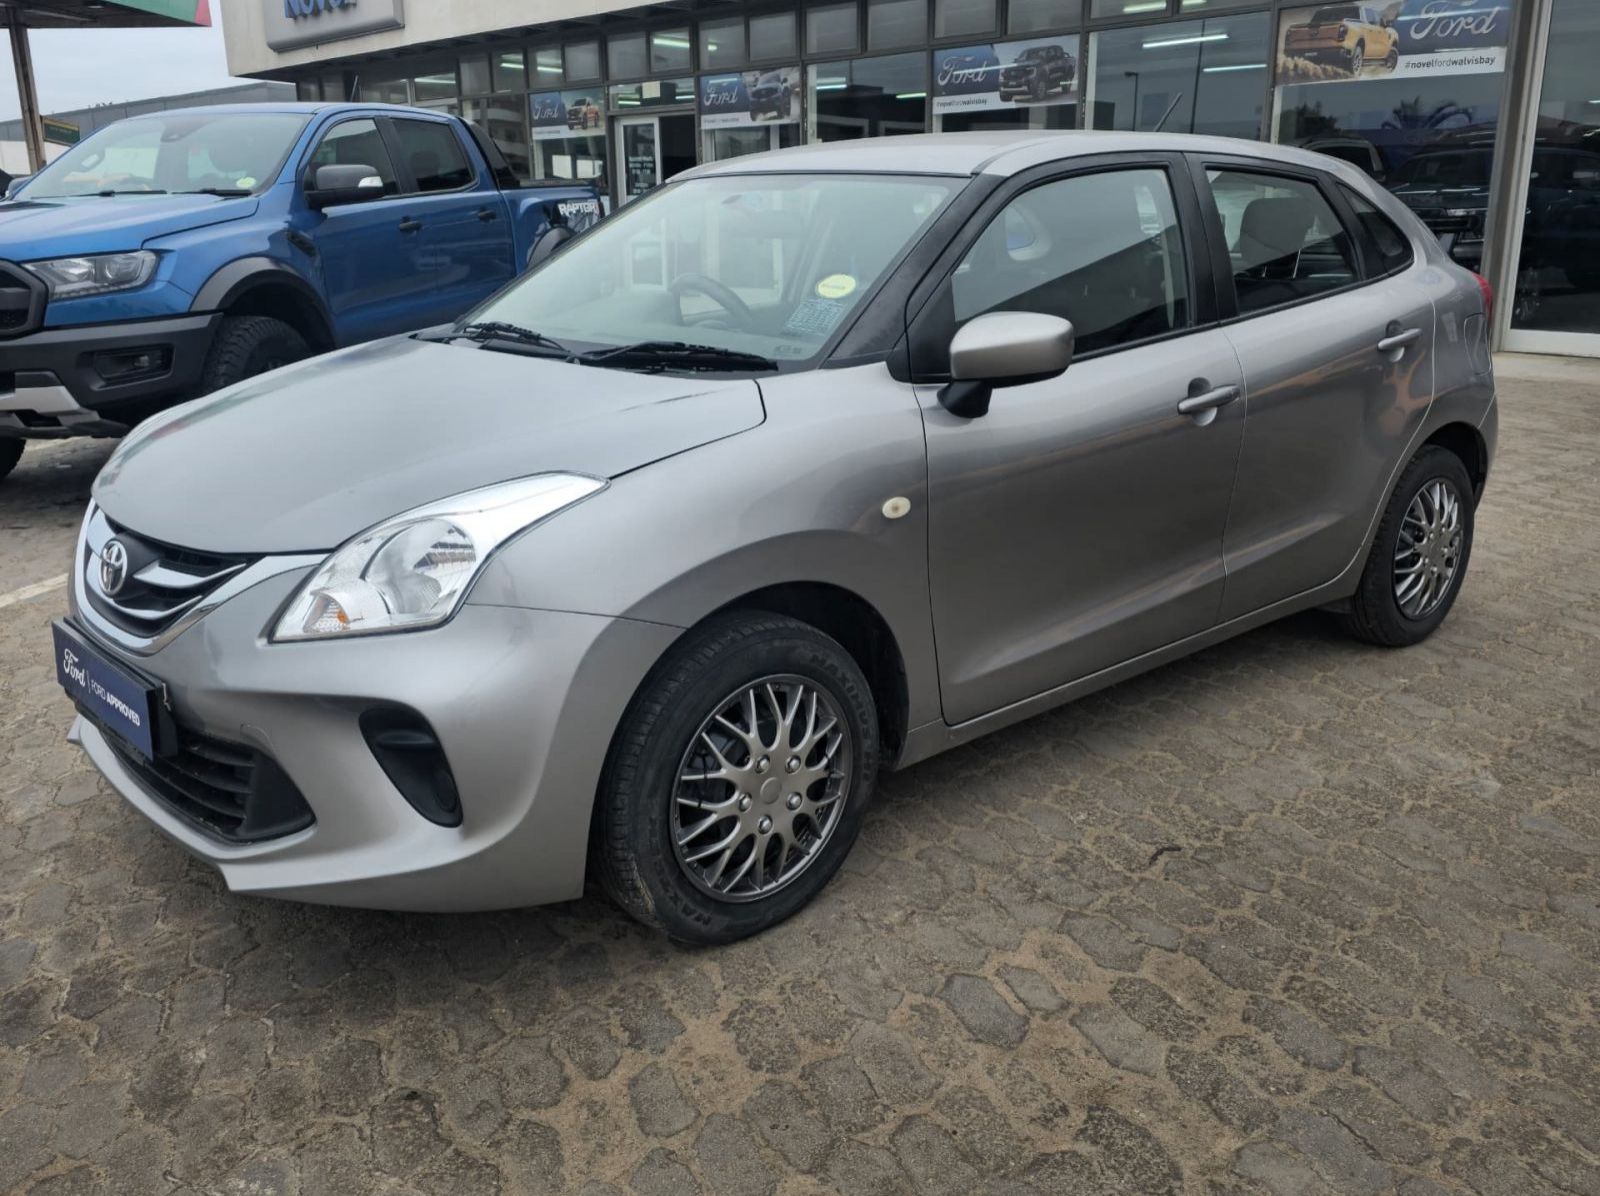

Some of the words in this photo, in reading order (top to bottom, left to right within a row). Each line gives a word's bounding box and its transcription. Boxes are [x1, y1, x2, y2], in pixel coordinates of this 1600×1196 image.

[1410, 0, 1498, 39] Ford
[937, 56, 987, 86] Ford
[1404, 56, 1496, 69] #novelfordwalvisbay
[703, 81, 738, 106] Ford
[533, 99, 559, 120] Ford
[558, 200, 599, 217] RAPTOR
[63, 648, 86, 687] Ford
[91, 679, 106, 701] FORD
[106, 692, 141, 727] APPROVED
